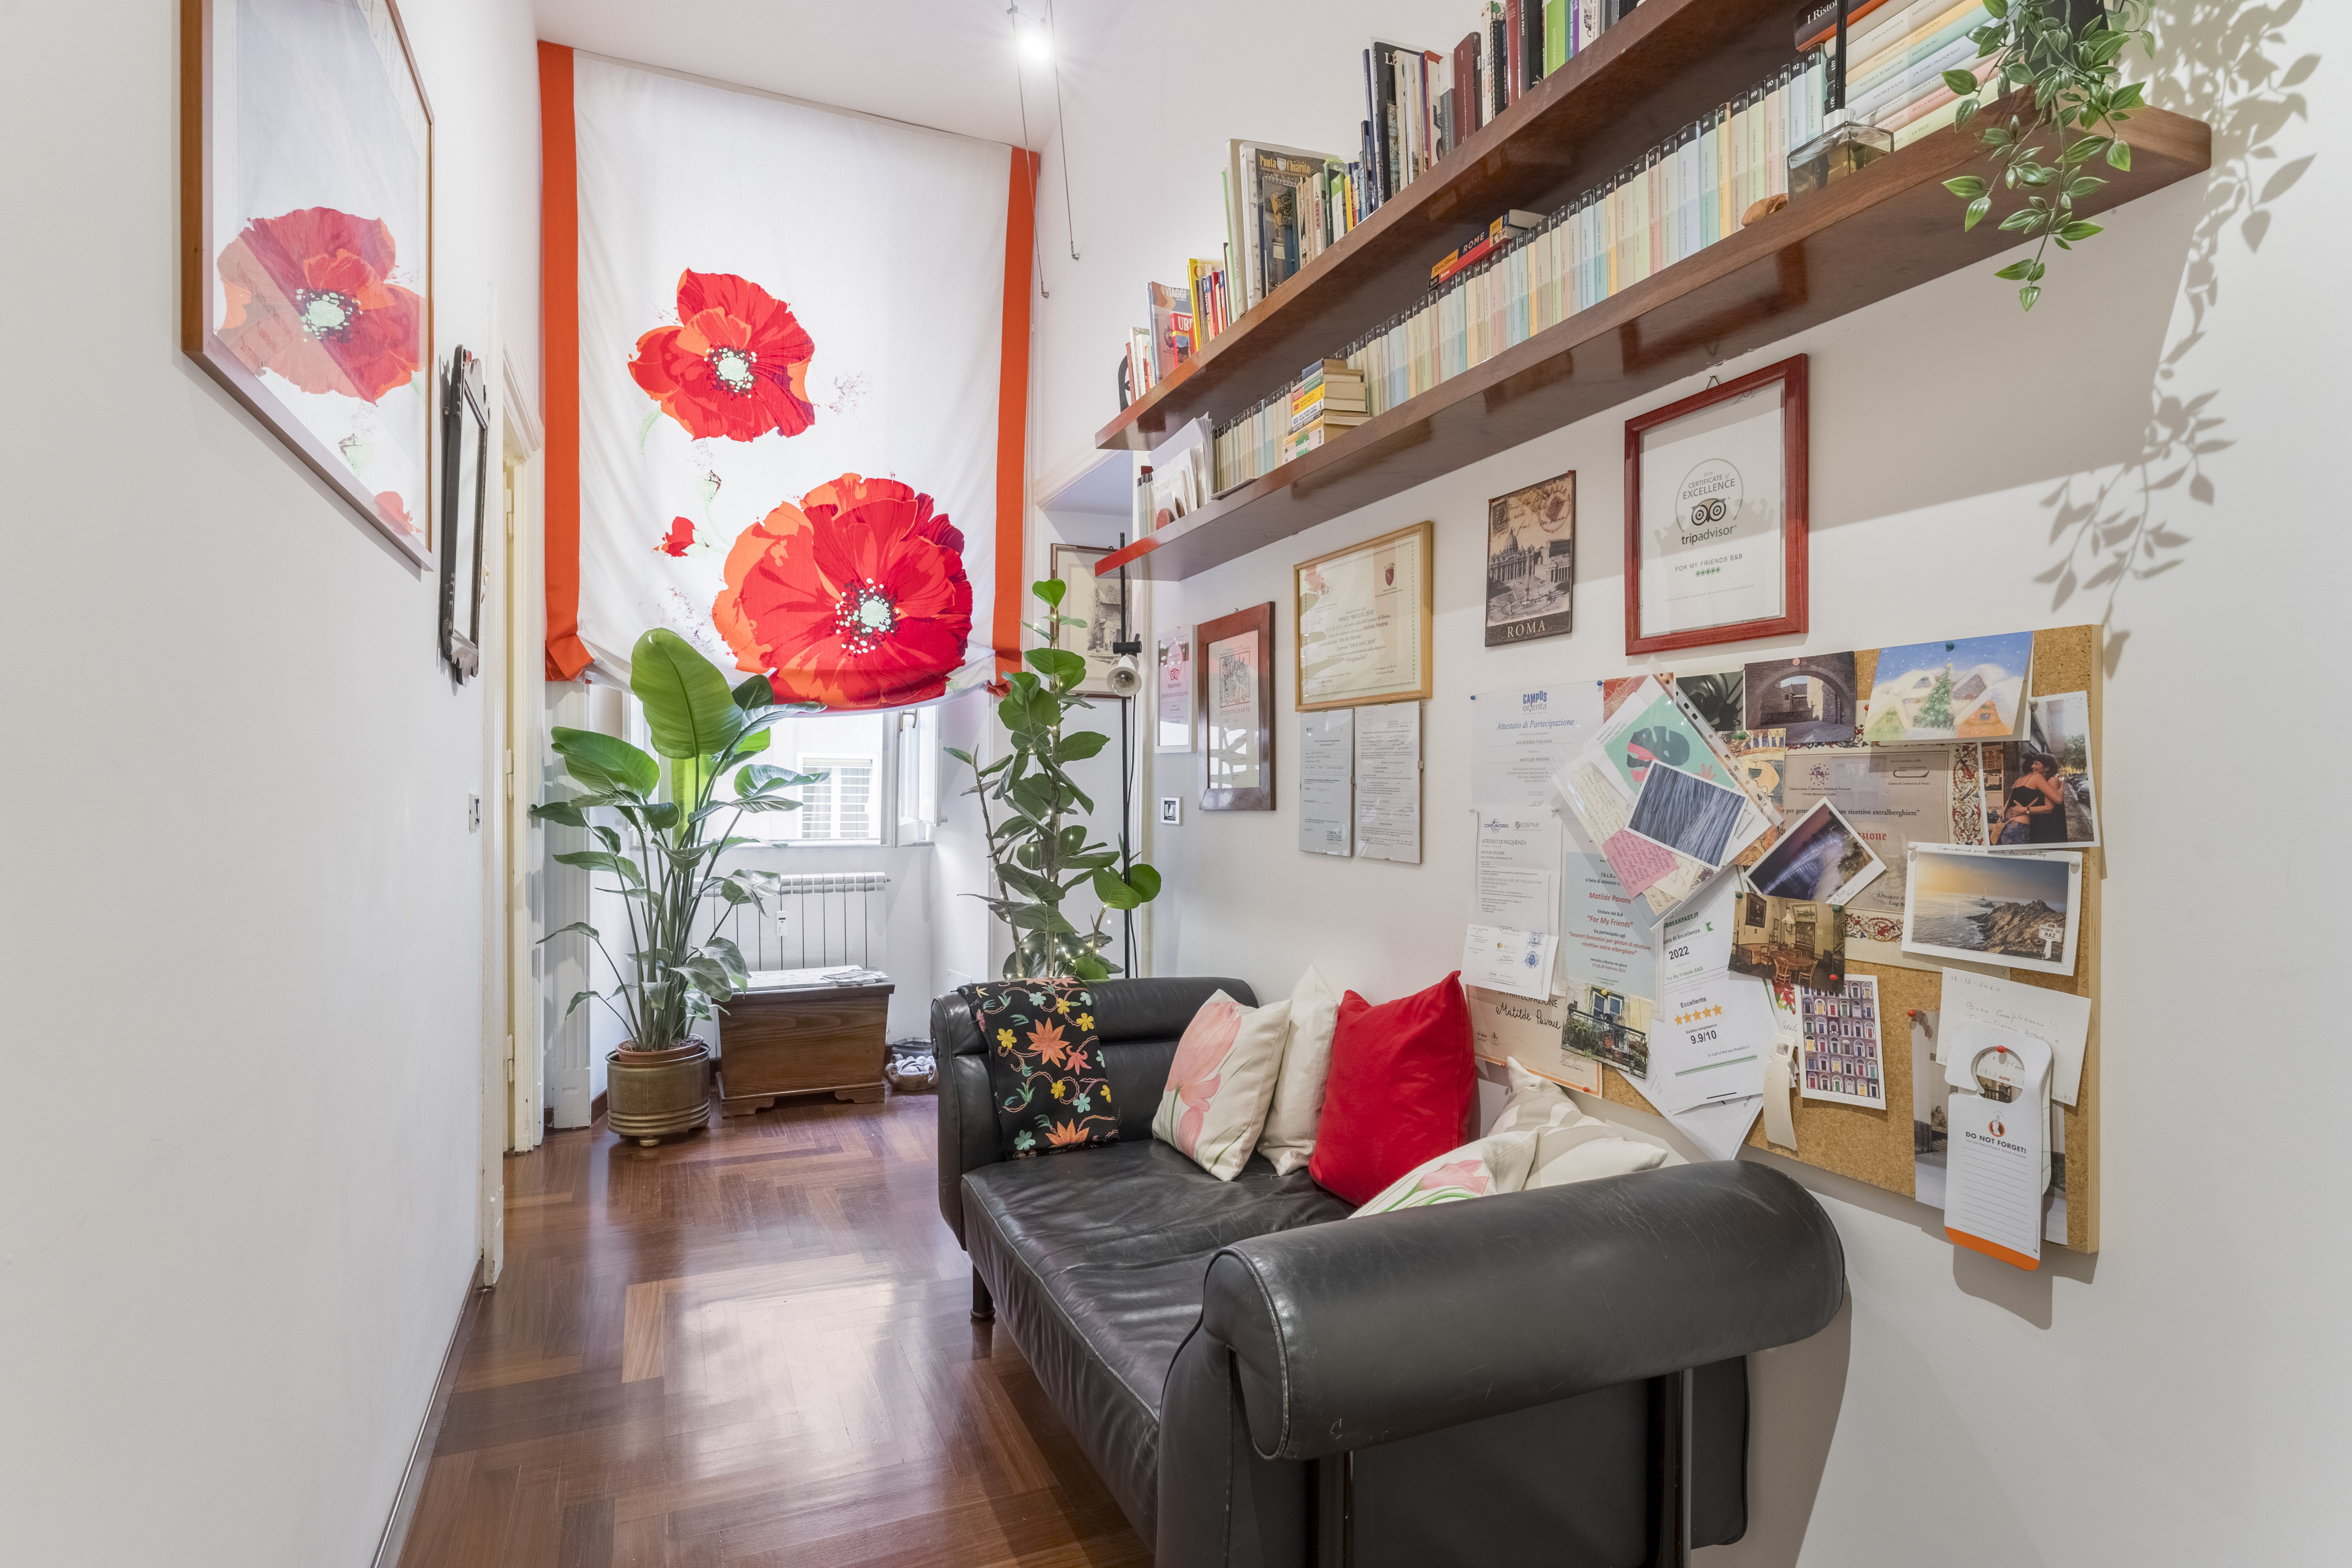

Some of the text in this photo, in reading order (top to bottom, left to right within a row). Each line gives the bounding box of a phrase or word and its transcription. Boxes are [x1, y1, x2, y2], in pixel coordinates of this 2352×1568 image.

[1925, 21, 1940, 31] DONNA
[1912, 39, 1938, 56] PASTO NUDO
[1808, 53, 1815, 62] 93
[1920, 63, 1933, 73] UOMO
[1934, 47, 1960, 64] TRANQUILLO
[1793, 63, 1799, 72] 92
[1859, 59, 1903, 87] WILLIAM BURROUGHS
[1873, 79, 1905, 100] MAURICE WALSH
[1918, 123, 1929, 132] PELLE
[1260, 155, 1310, 174] Punta Chiarito
[1463, 222, 1500, 253] ROME 2013
[1441, 270, 1450, 279] Rome
[1165, 287, 1187, 299] VIAGGI
[1688, 474, 1723, 488] CERTIFICATE
[1683, 478, 1735, 500] EXCELLENCE
[1681, 525, 1734, 545] tripadvisor
[1700, 557, 1728, 567] FRIENDS
[1508, 620, 1546, 637] ROMA
[1523, 691, 1547, 704] CAMPUS
[1530, 719, 1574, 729] Partecipazione
[1589, 892, 1631, 904] Matilde Pavone
[1677, 928, 1700, 939] Eccellenza
[1669, 946, 1690, 960] 2022
[1681, 997, 1706, 1008] Eccellente
[1496, 1002, 1531, 1021] Matilde
[1691, 1030, 1716, 1044] 9.9/10
[1973, 1141, 2000, 1151] UNFORGETTABLE
[1980, 1136, 1995, 1144] NOT
[1998, 1140, 2027, 1154] FORGET!
